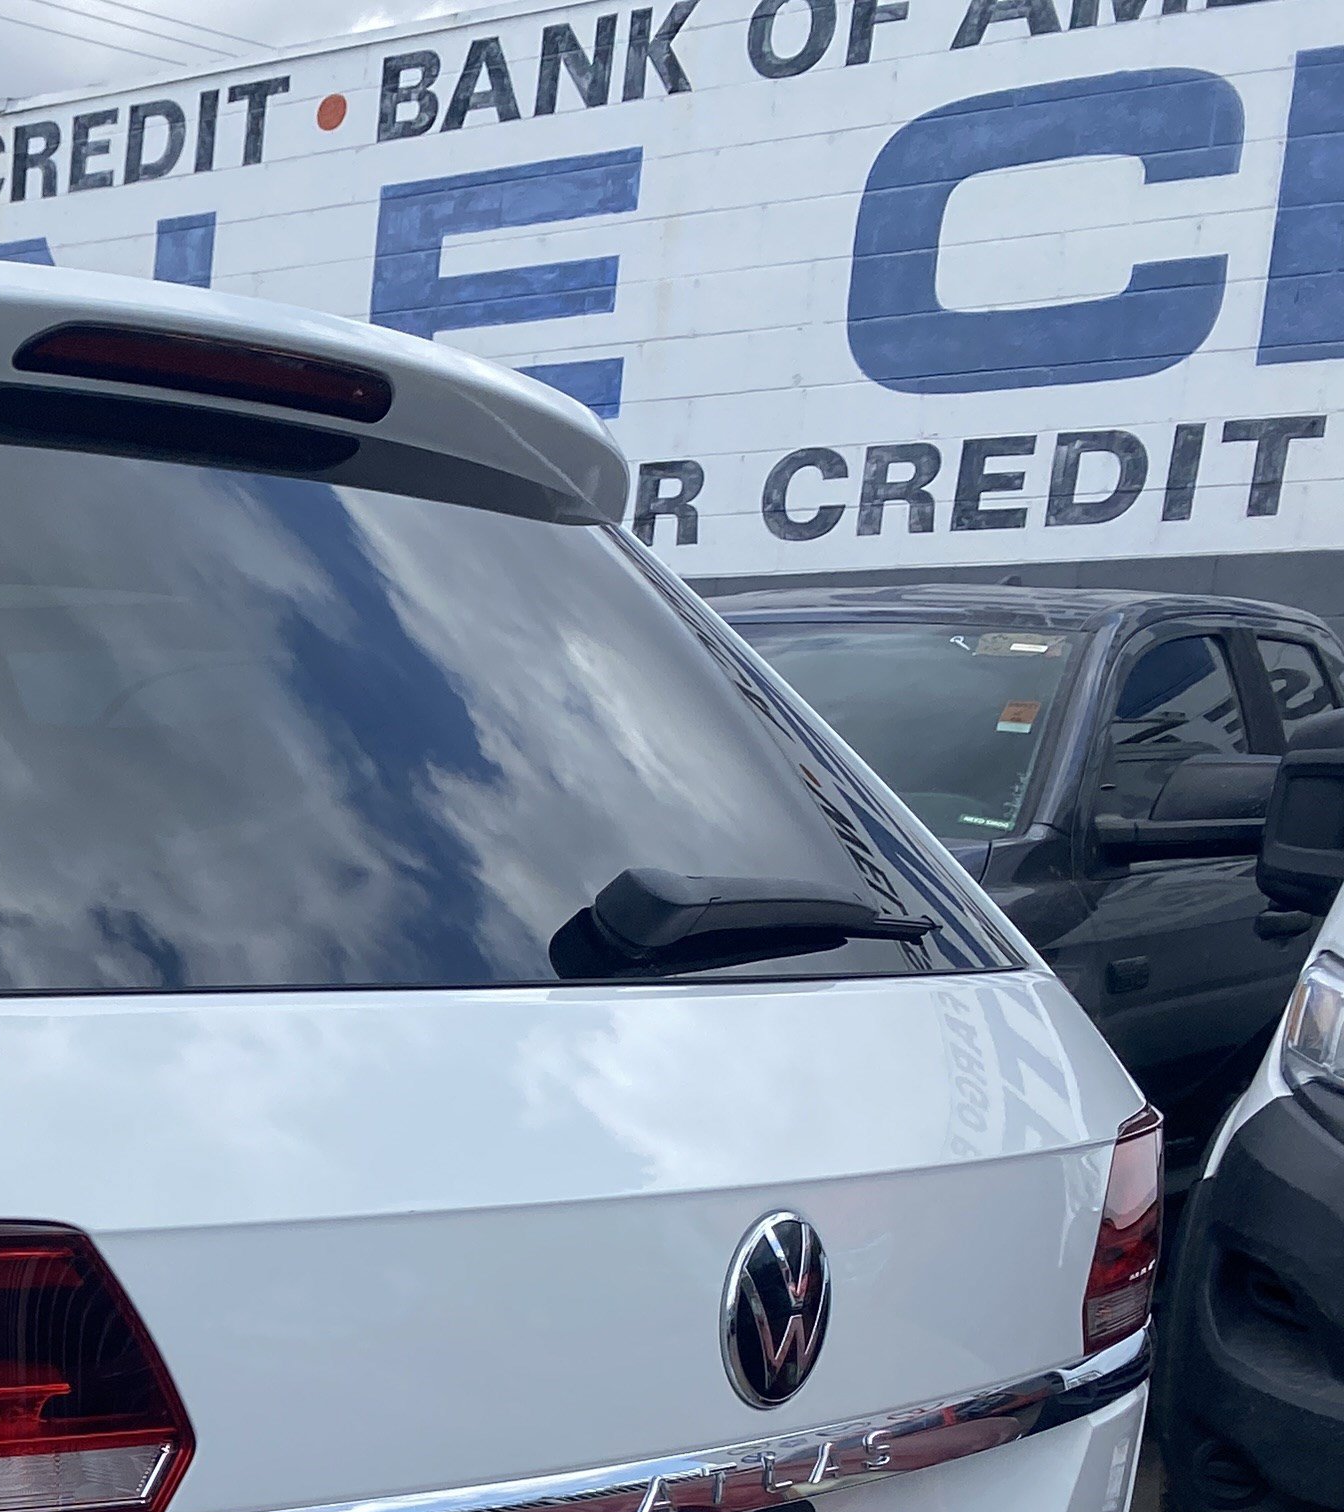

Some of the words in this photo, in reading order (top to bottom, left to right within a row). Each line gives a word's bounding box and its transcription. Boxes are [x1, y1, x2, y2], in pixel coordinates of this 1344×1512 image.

[376, 0, 699, 143] BANK
[747, 0, 911, 80] OF
[761, 414, 1328, 542] CREDIT
